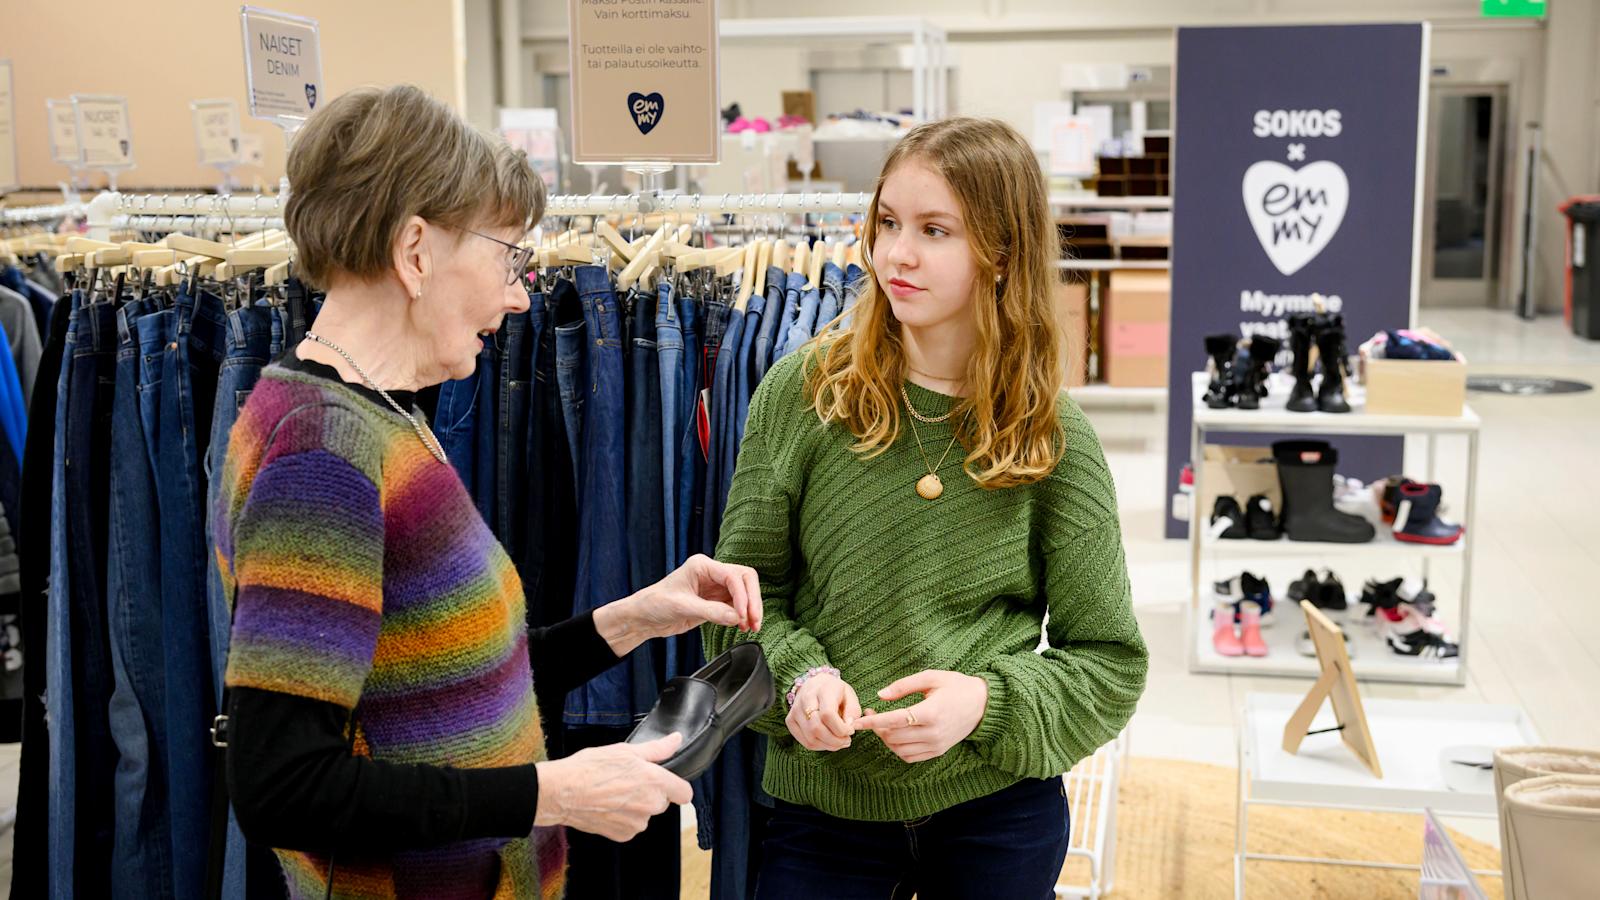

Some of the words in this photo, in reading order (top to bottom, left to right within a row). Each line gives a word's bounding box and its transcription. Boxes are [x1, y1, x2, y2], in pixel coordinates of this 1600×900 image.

[593, 9, 619, 19] Vain
[621, 9, 691, 19] korttimaksu.
[259, 31, 303, 56] NAISET
[581, 44, 633, 54] Tuotteilla
[635, 44, 646, 54] ei
[647, 44, 665, 54] ole
[667, 44, 708, 54] vaihto-
[266, 58, 300, 77] DENIM
[587, 58, 602, 69] tai
[604, 58, 701, 71] palautusoikeutta.
[1253, 109, 1343, 138] SOKOS
